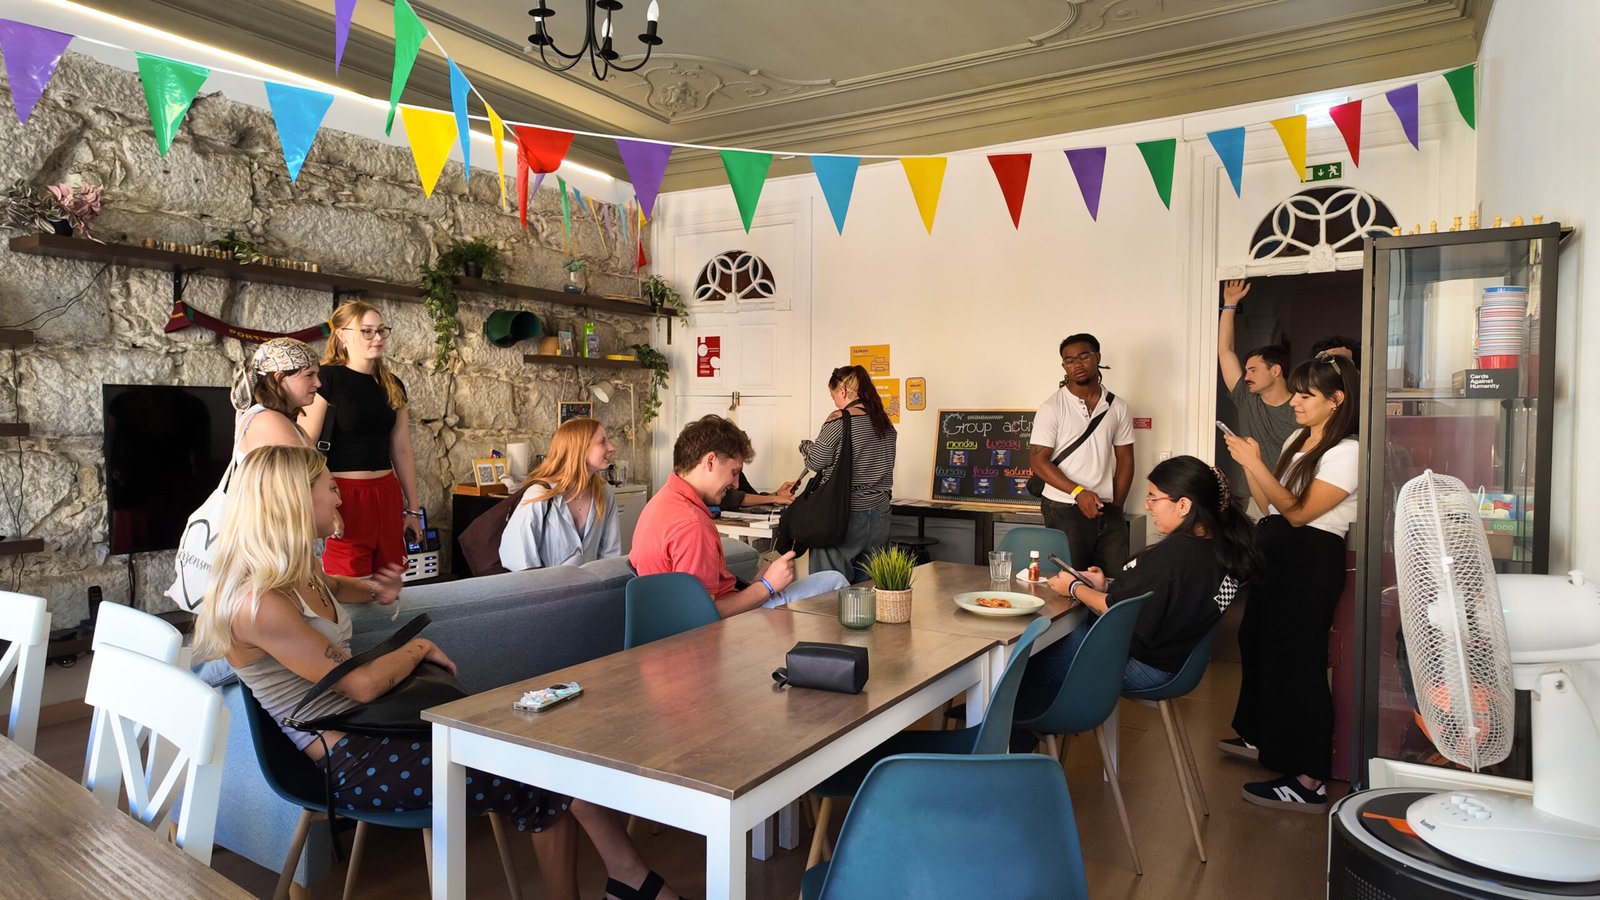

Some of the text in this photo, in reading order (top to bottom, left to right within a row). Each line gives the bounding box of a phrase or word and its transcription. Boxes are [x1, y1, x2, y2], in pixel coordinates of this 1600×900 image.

[943, 413, 992, 437] Group
[946, 439, 978, 450] monday
[986, 439, 1021, 451] tuesday
[972, 466, 999, 477] friday
